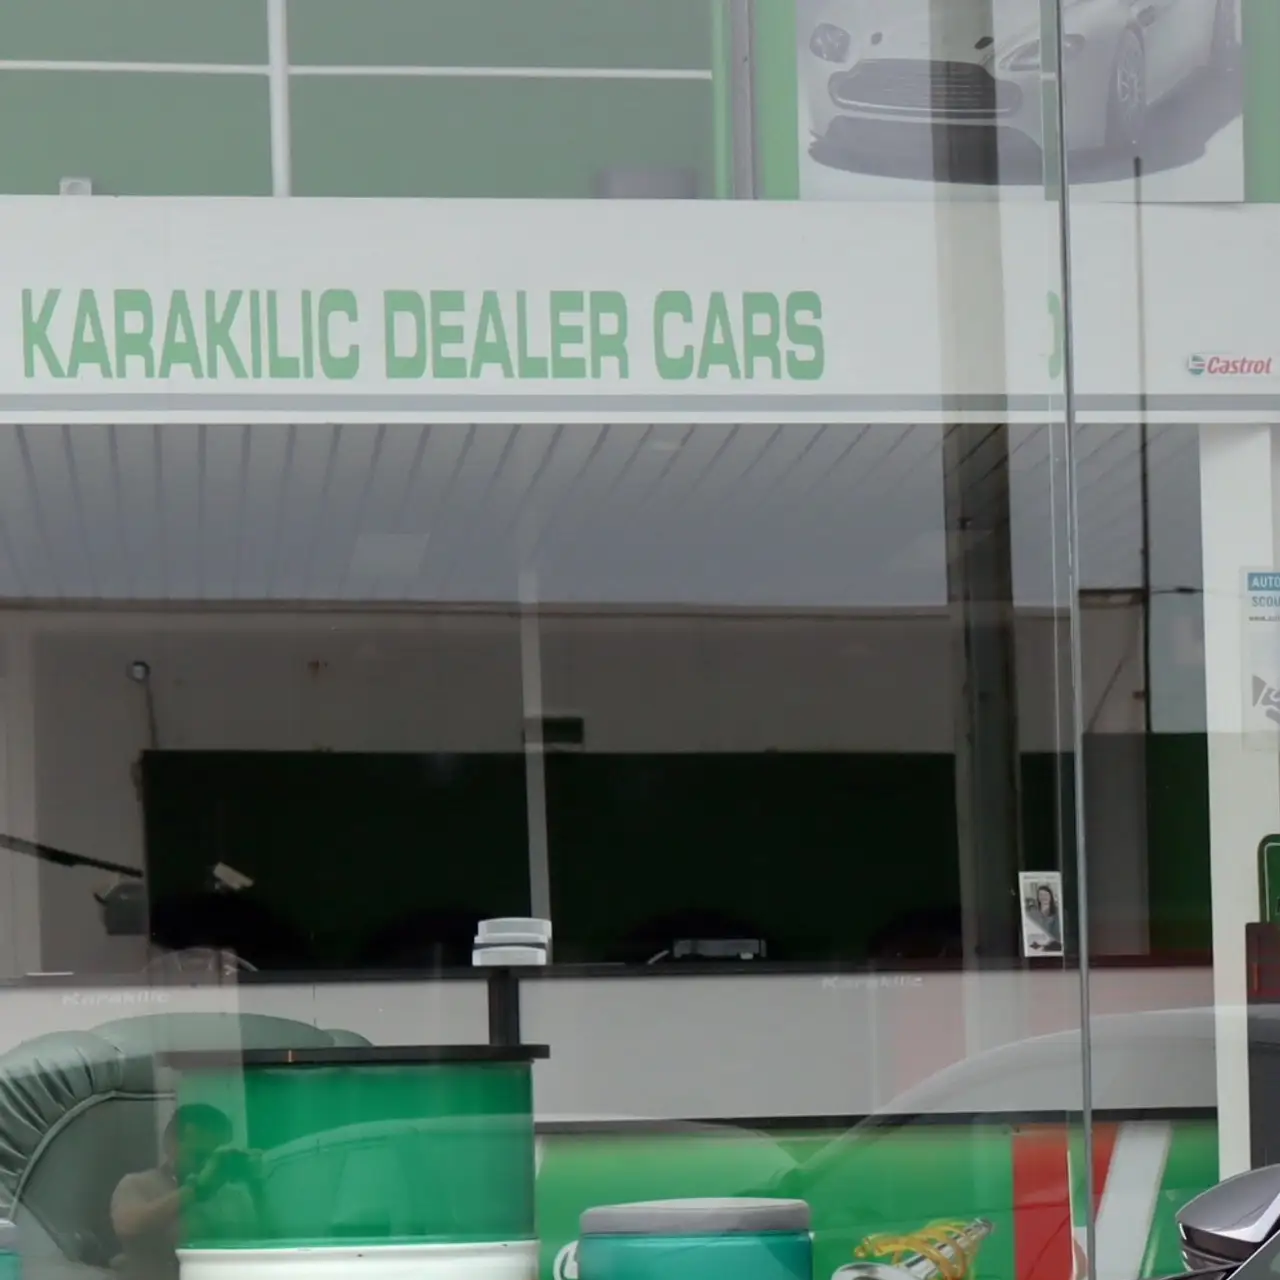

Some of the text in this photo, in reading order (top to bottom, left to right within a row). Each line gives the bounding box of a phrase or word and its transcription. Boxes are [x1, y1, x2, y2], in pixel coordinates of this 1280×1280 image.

[21, 288, 825, 382] KARAKILIC DEALER CARS
[1206, 355, 1273, 375] Castrol
